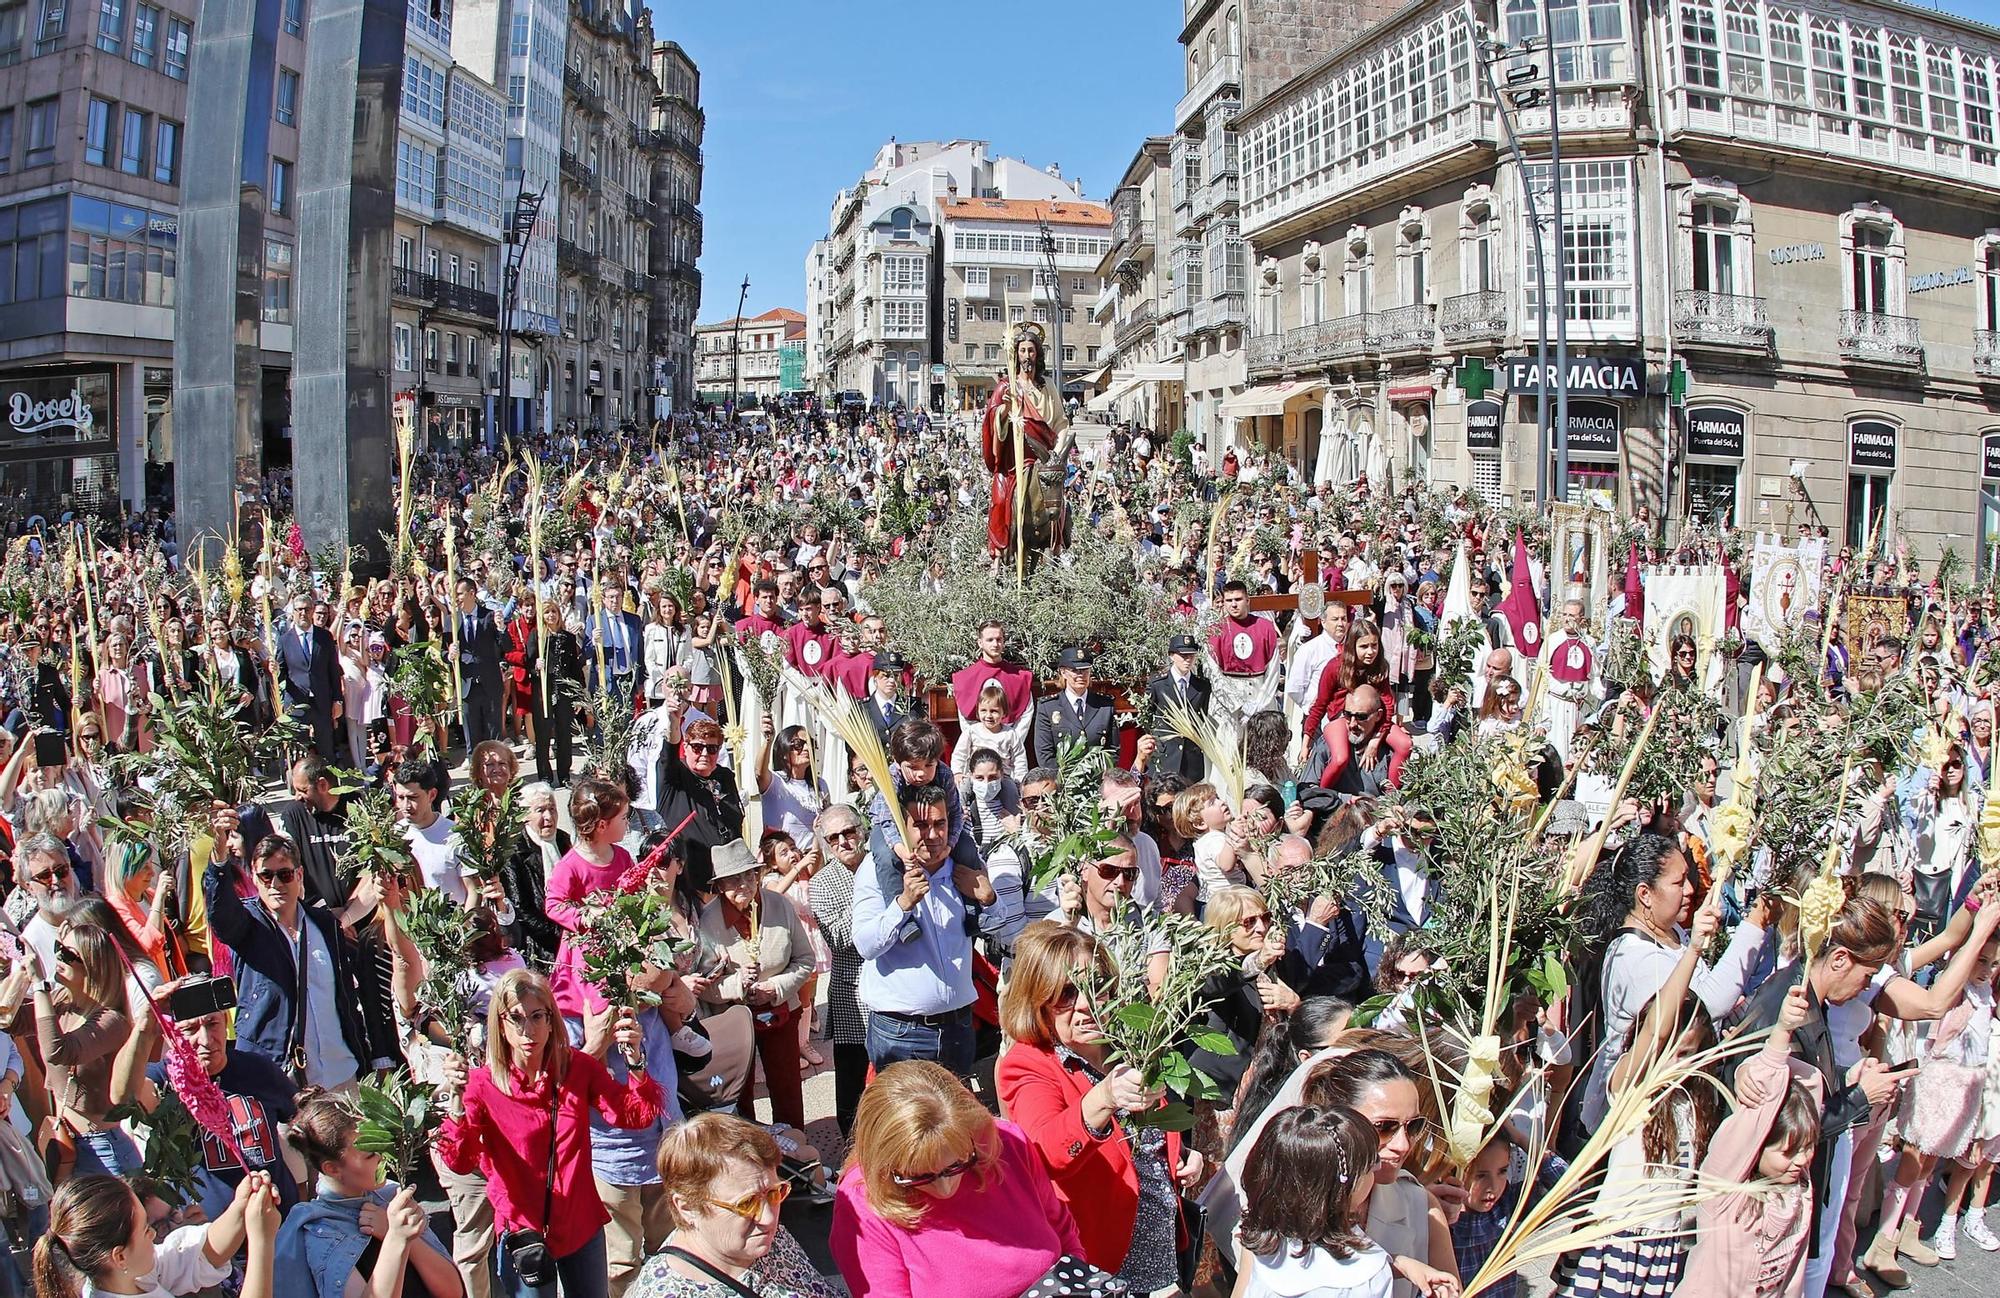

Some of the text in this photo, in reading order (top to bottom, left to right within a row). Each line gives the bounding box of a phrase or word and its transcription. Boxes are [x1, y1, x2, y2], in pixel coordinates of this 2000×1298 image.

[150, 219, 178, 235] OCASO
[1769, 242, 1825, 265] COSTURA
[1513, 364, 1638, 390] FARMACIA
[9, 389, 93, 425] Dooers
[1468, 416, 1498, 427] FARMACIA
[1554, 416, 1615, 430] FRMACIA
[1691, 421, 1742, 436] FARMACIA
[1582, 433, 1592, 442] del
[1592, 434, 1605, 444] Sol,
[1694, 437, 1713, 446] Puerta
[1723, 439, 1734, 448] Sol,
[1853, 433, 1893, 446] FARMACIA
[1879, 451, 1887, 459] Sol,
[1587, 803, 1609, 812] ALE-H
